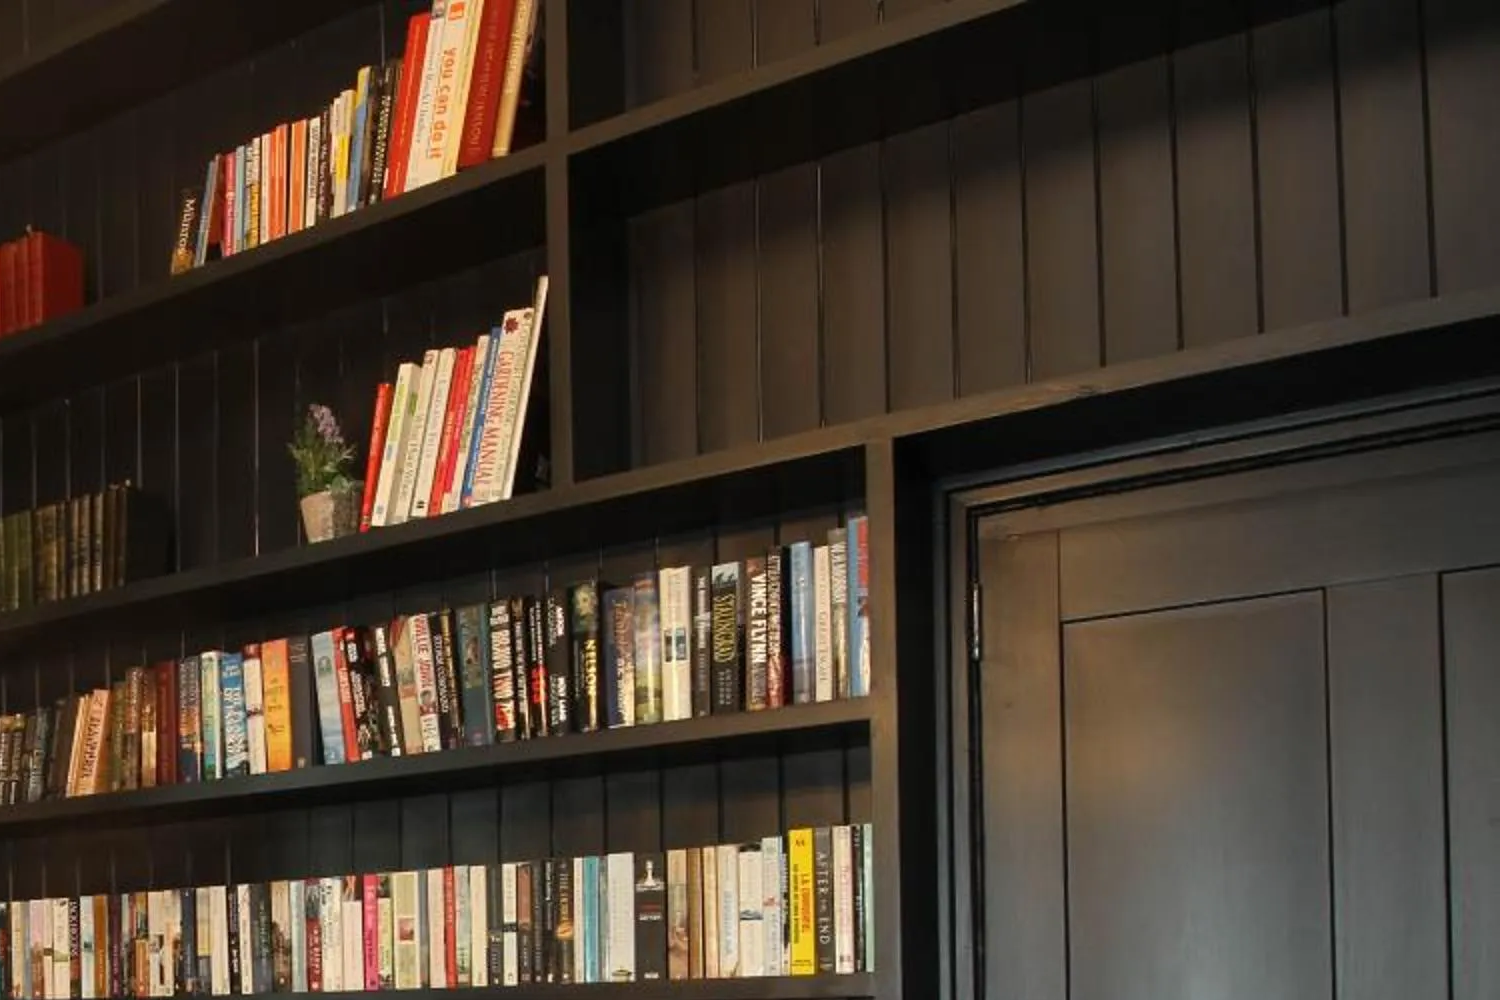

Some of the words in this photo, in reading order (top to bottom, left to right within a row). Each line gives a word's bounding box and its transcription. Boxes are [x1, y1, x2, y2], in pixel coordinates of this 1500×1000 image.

[443, 48, 458, 79] you
[435, 84, 452, 115] can
[432, 121, 445, 143] do
[487, 350, 514, 424] GARDENING
[476, 426, 500, 486] MANUAL
[751, 573, 766, 615] VINCE
[714, 593, 735, 663] STALINGRAD
[751, 619, 766, 663] FLYNN
[491, 629, 511, 669] BRAVO
[585, 639, 596, 696] NELSON
[492, 670, 514, 699] TWO
[496, 700, 515, 731] ZERO
[816, 851, 830, 894] AFTER
[819, 917, 831, 945] END
